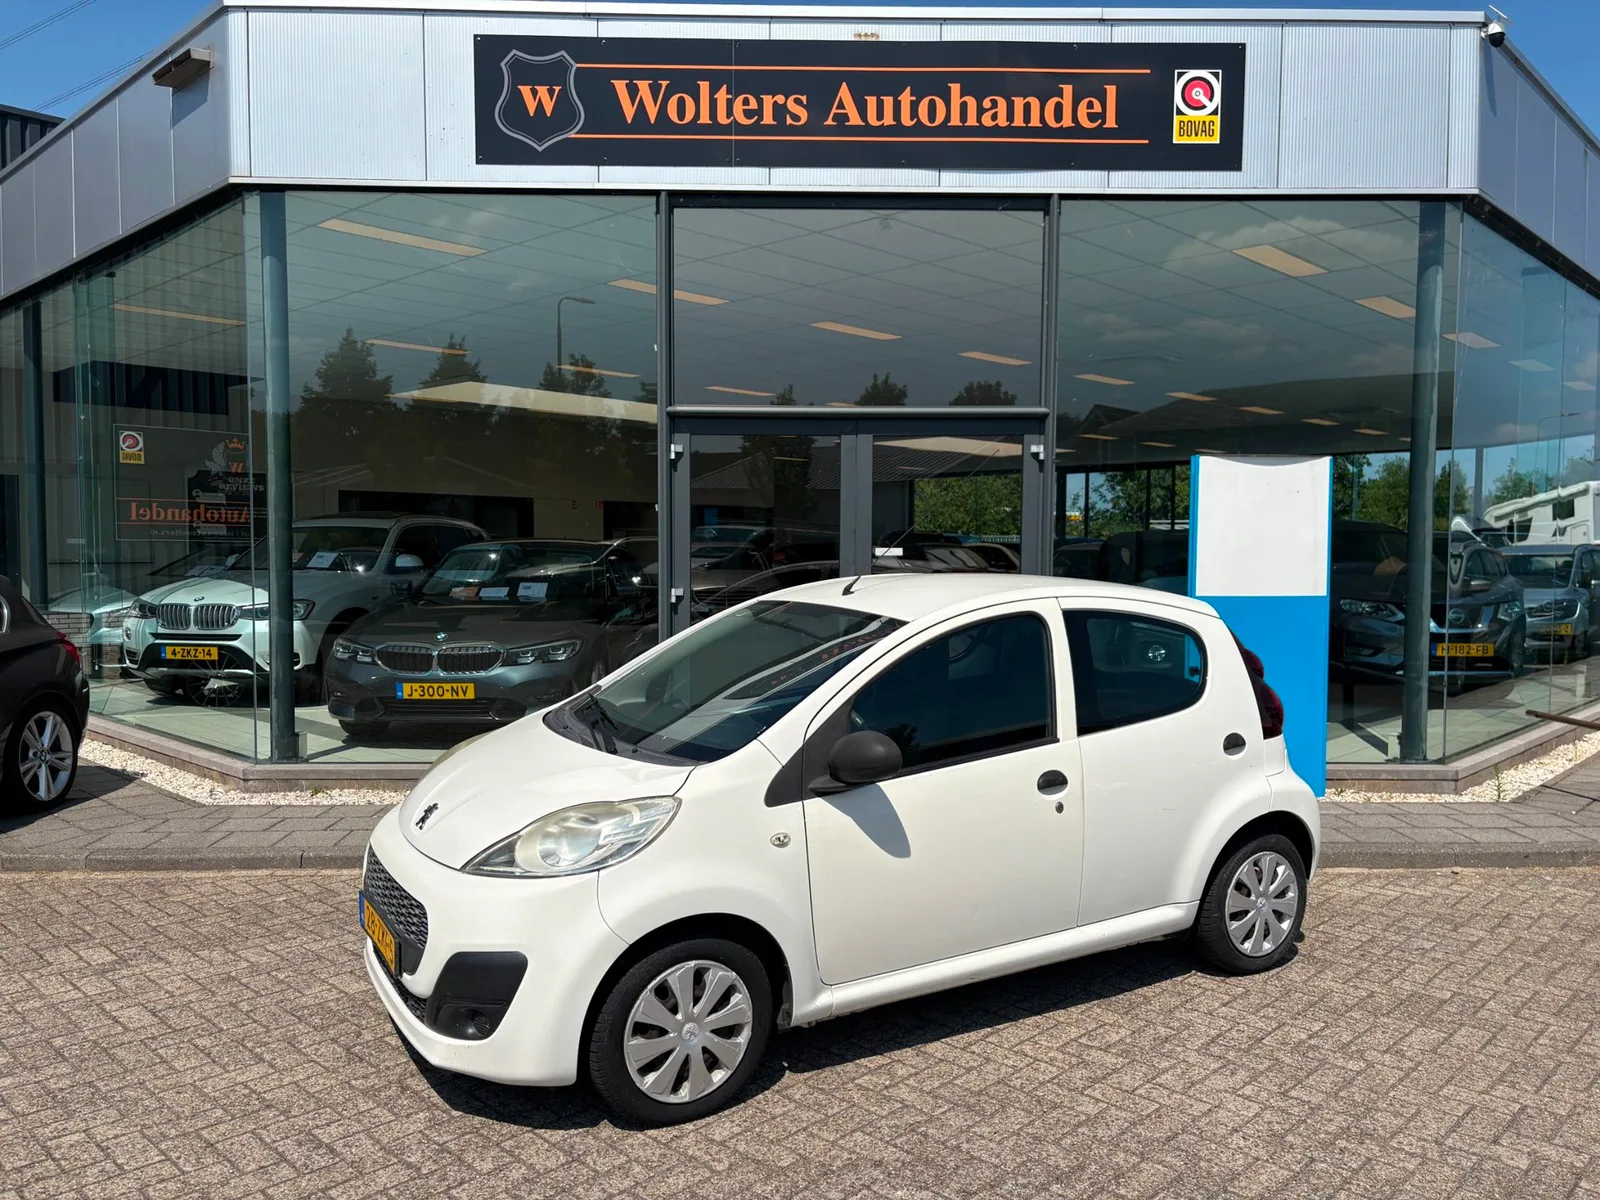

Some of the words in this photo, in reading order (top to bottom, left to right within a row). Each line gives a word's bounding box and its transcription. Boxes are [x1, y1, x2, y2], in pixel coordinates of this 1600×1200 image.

[518, 84, 560, 117] W
[612, 79, 809, 127] Wolters
[824, 81, 1119, 130] Autohandel
[1178, 120, 1215, 137] BOVAG
[171, 647, 213, 659] 4-ZKZ-14
[407, 685, 469, 698] J-300-NV
